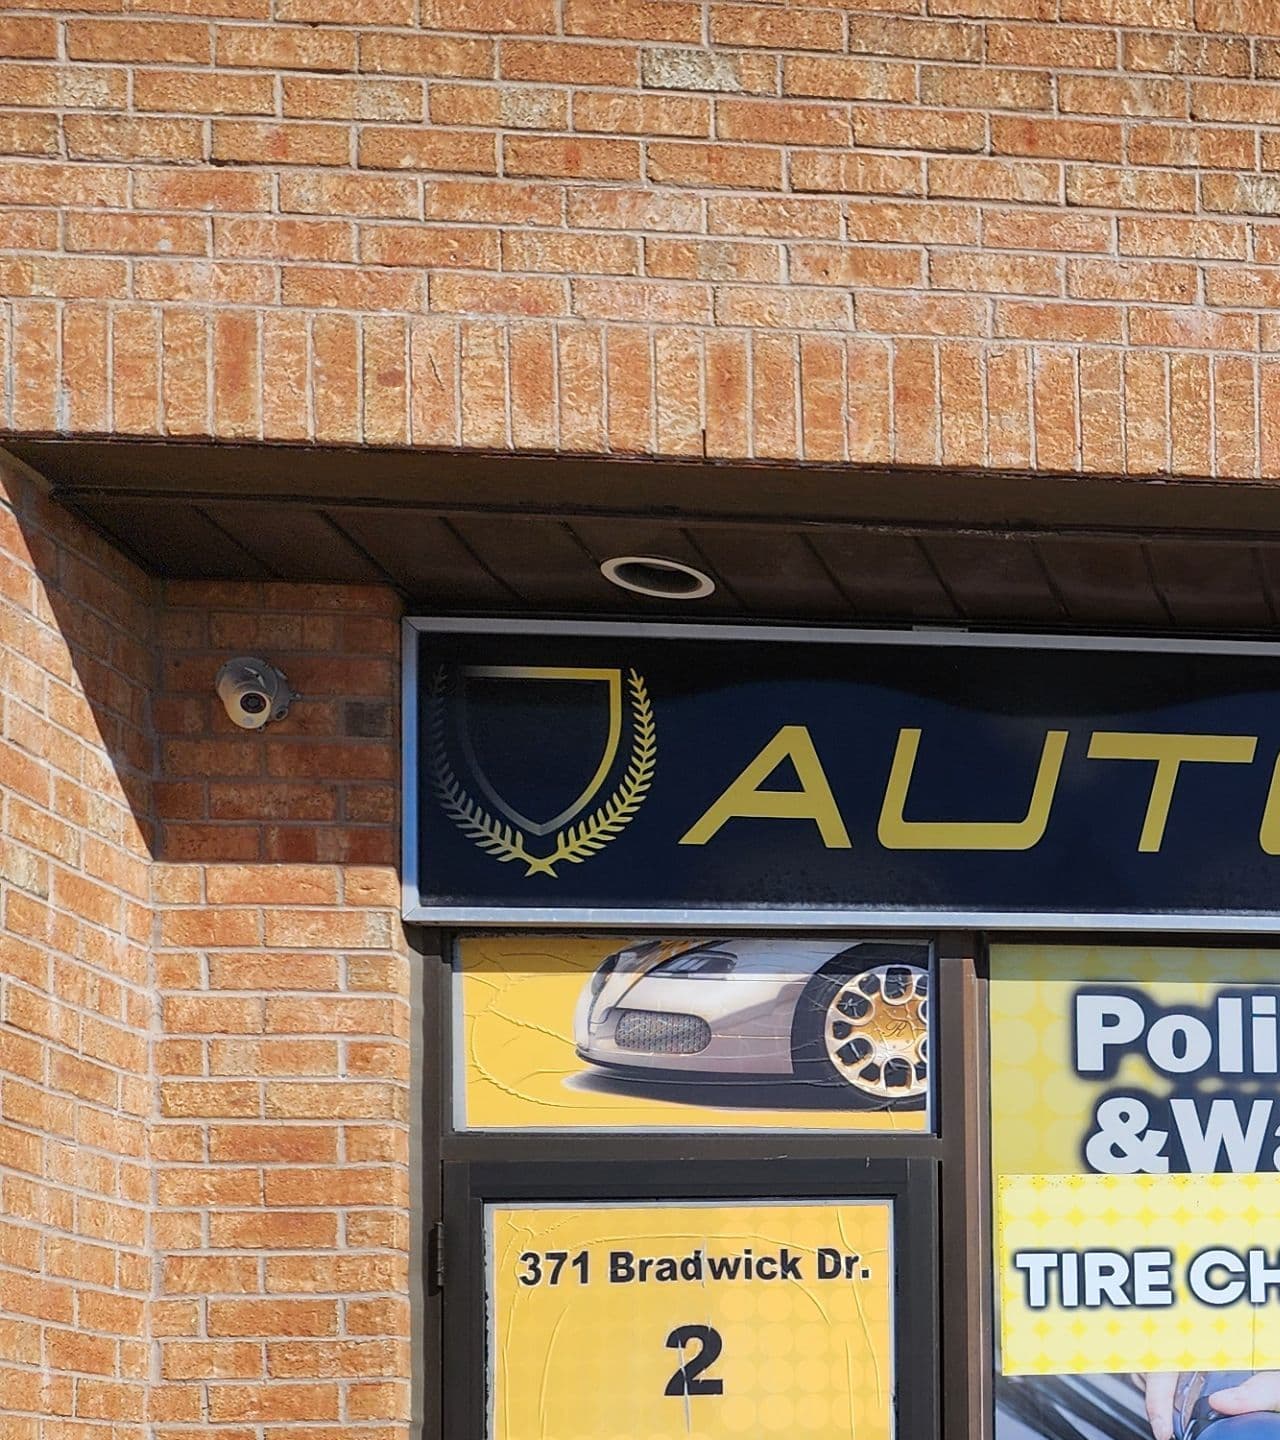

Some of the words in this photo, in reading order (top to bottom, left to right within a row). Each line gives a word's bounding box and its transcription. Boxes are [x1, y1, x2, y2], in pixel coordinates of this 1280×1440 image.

[518, 1251, 590, 1286] 371
[608, 1249, 801, 1283] Bradwick
[817, 1248, 870, 1280] Dr.
[1015, 1250, 1172, 1307] TIRE
[664, 1324, 724, 1396] 2
